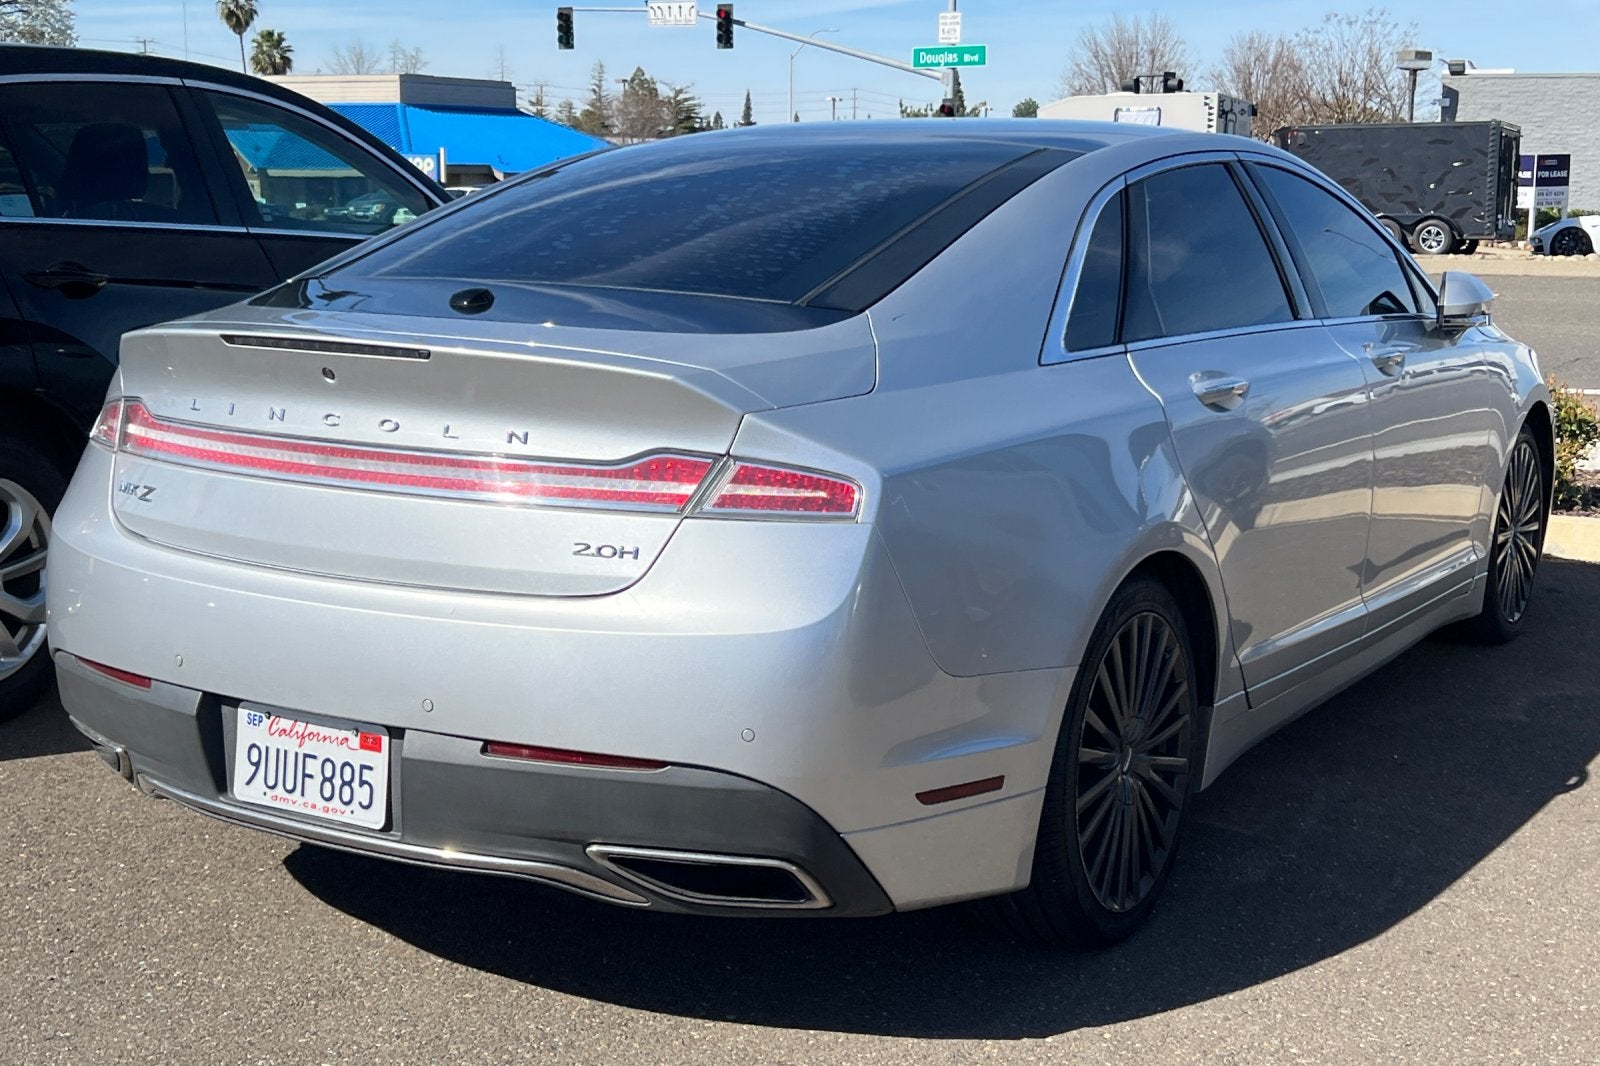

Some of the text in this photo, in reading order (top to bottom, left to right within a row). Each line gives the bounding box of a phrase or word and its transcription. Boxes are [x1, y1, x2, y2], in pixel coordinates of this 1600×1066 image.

[919, 51, 979, 67] Douglas Blvd
[407, 157, 435, 175] op
[1537, 170, 1568, 178] FOR LEASE
[190, 397, 529, 445] LINCOLN
[246, 712, 264, 727] SEP
[268, 716, 359, 751] California
[244, 743, 374, 810] 9UUF885
[270, 794, 346, 815] dmv.ca.gov
